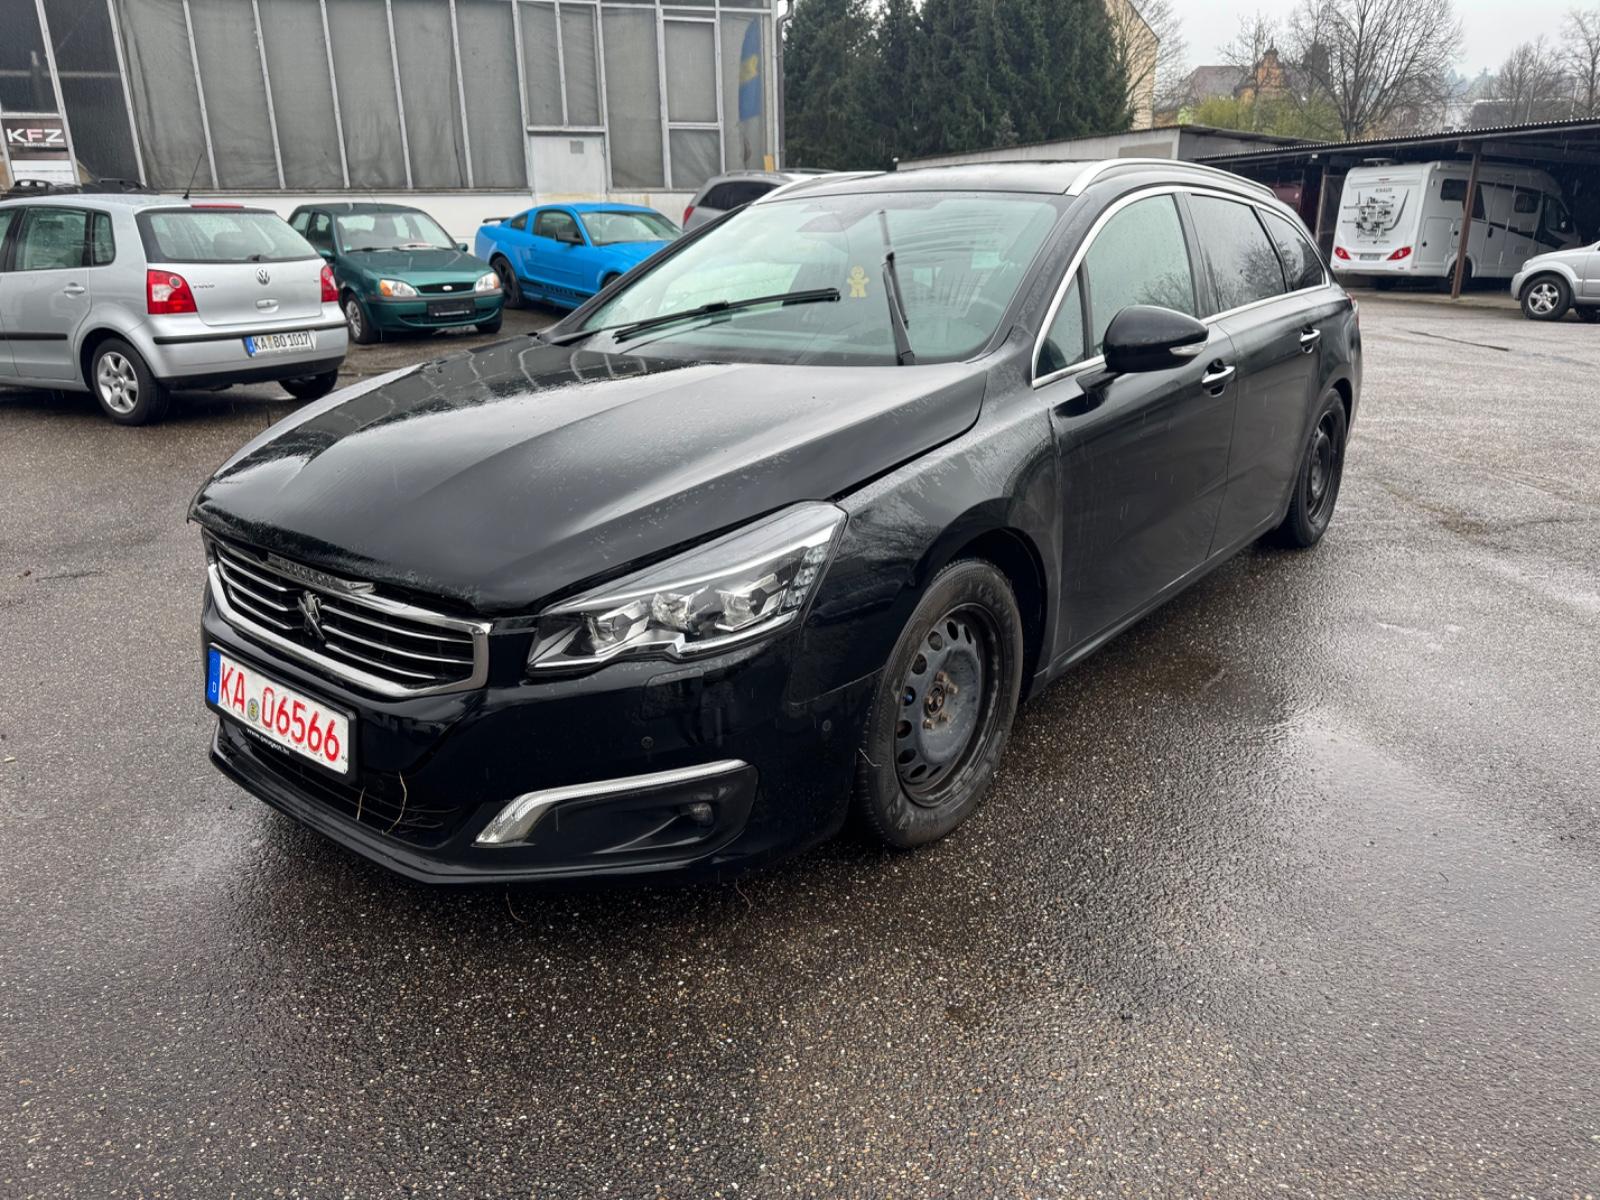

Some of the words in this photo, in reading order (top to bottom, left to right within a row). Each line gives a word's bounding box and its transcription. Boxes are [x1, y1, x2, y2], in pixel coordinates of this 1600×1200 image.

[6, 128, 65, 143] KFZ
[253, 336, 268, 351] KA
[289, 332, 309, 346] 1017
[212, 681, 217, 693] D
[221, 662, 245, 714] KA
[261, 686, 340, 762] 06566
